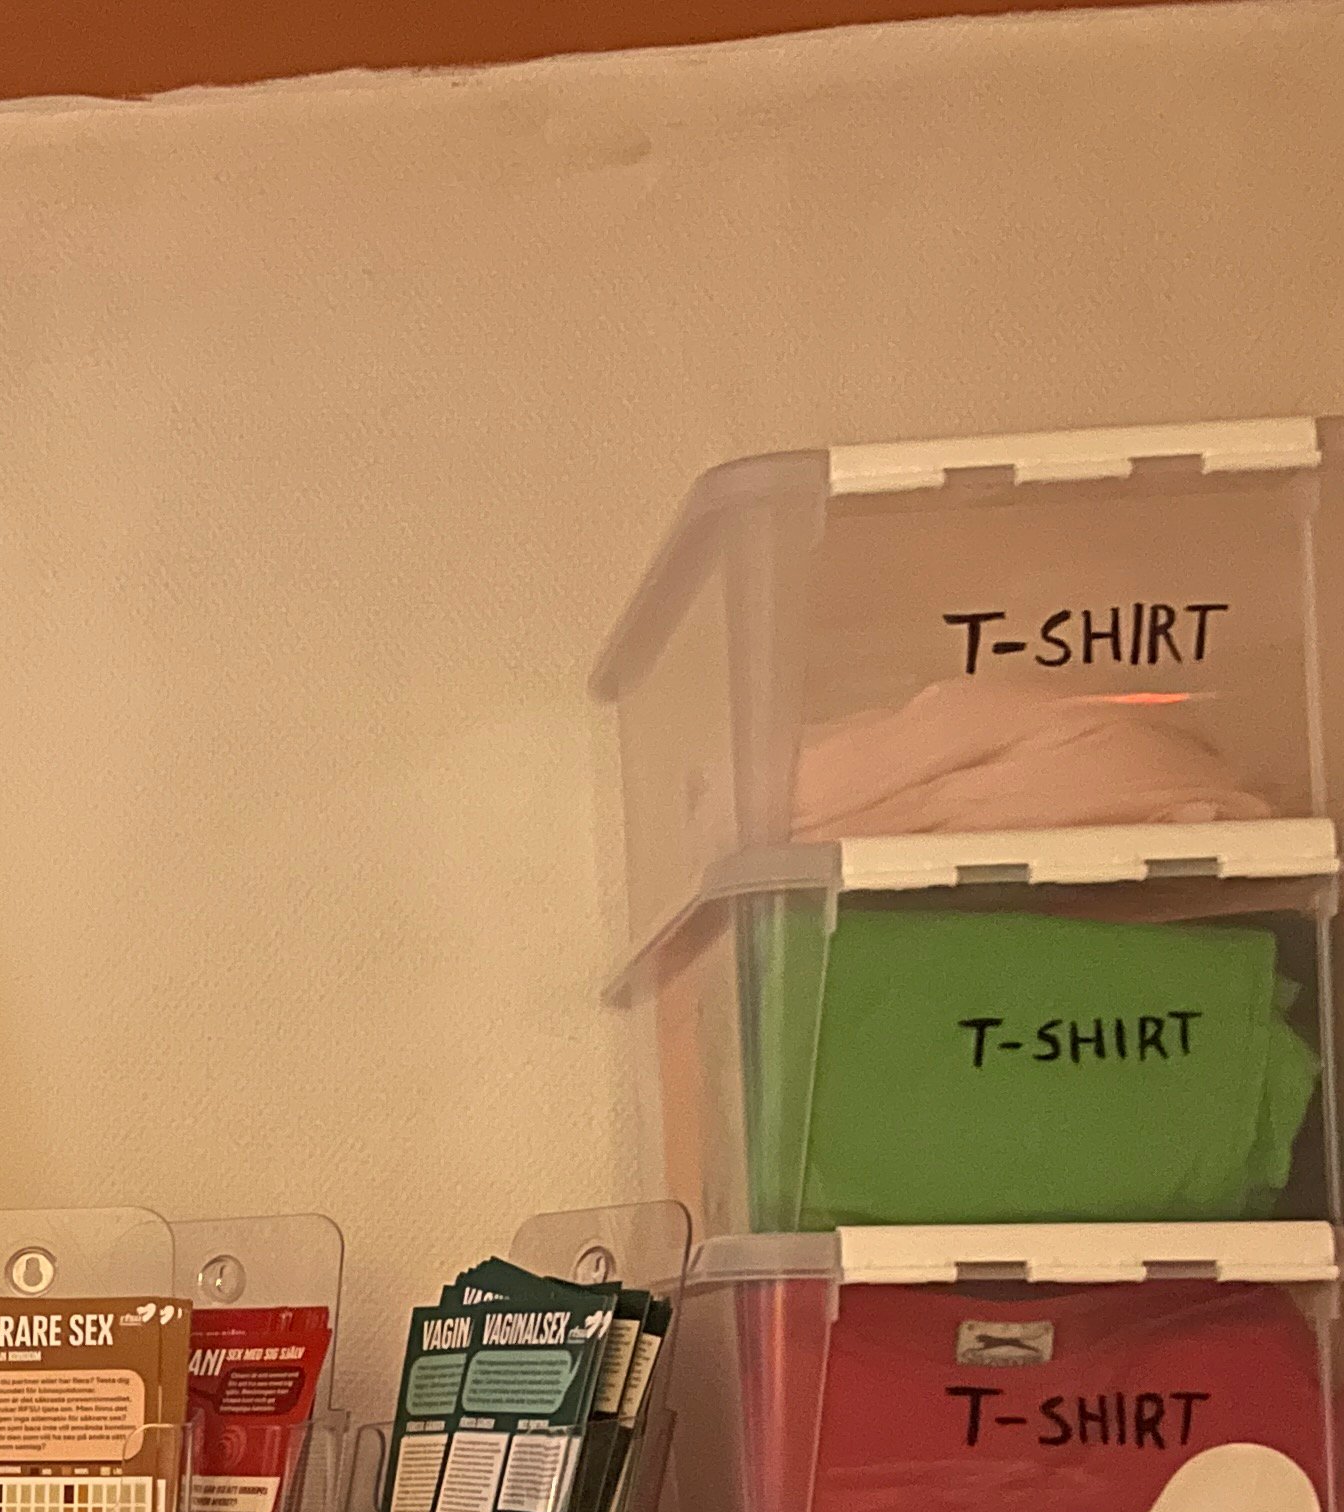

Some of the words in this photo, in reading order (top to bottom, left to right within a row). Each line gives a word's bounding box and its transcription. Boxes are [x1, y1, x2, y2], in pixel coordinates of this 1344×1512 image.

[943, 602, 1229, 675] T-SHIRT
[958, 1011, 1203, 1068] T-SHIRT
[69, 1314, 114, 1346] SEX
[423, 1317, 473, 1351] VAGIN
[482, 1312, 571, 1345] VAGINALSEX
[189, 1349, 226, 1376] ANI
[946, 1386, 1210, 1450] T-SHIRT
